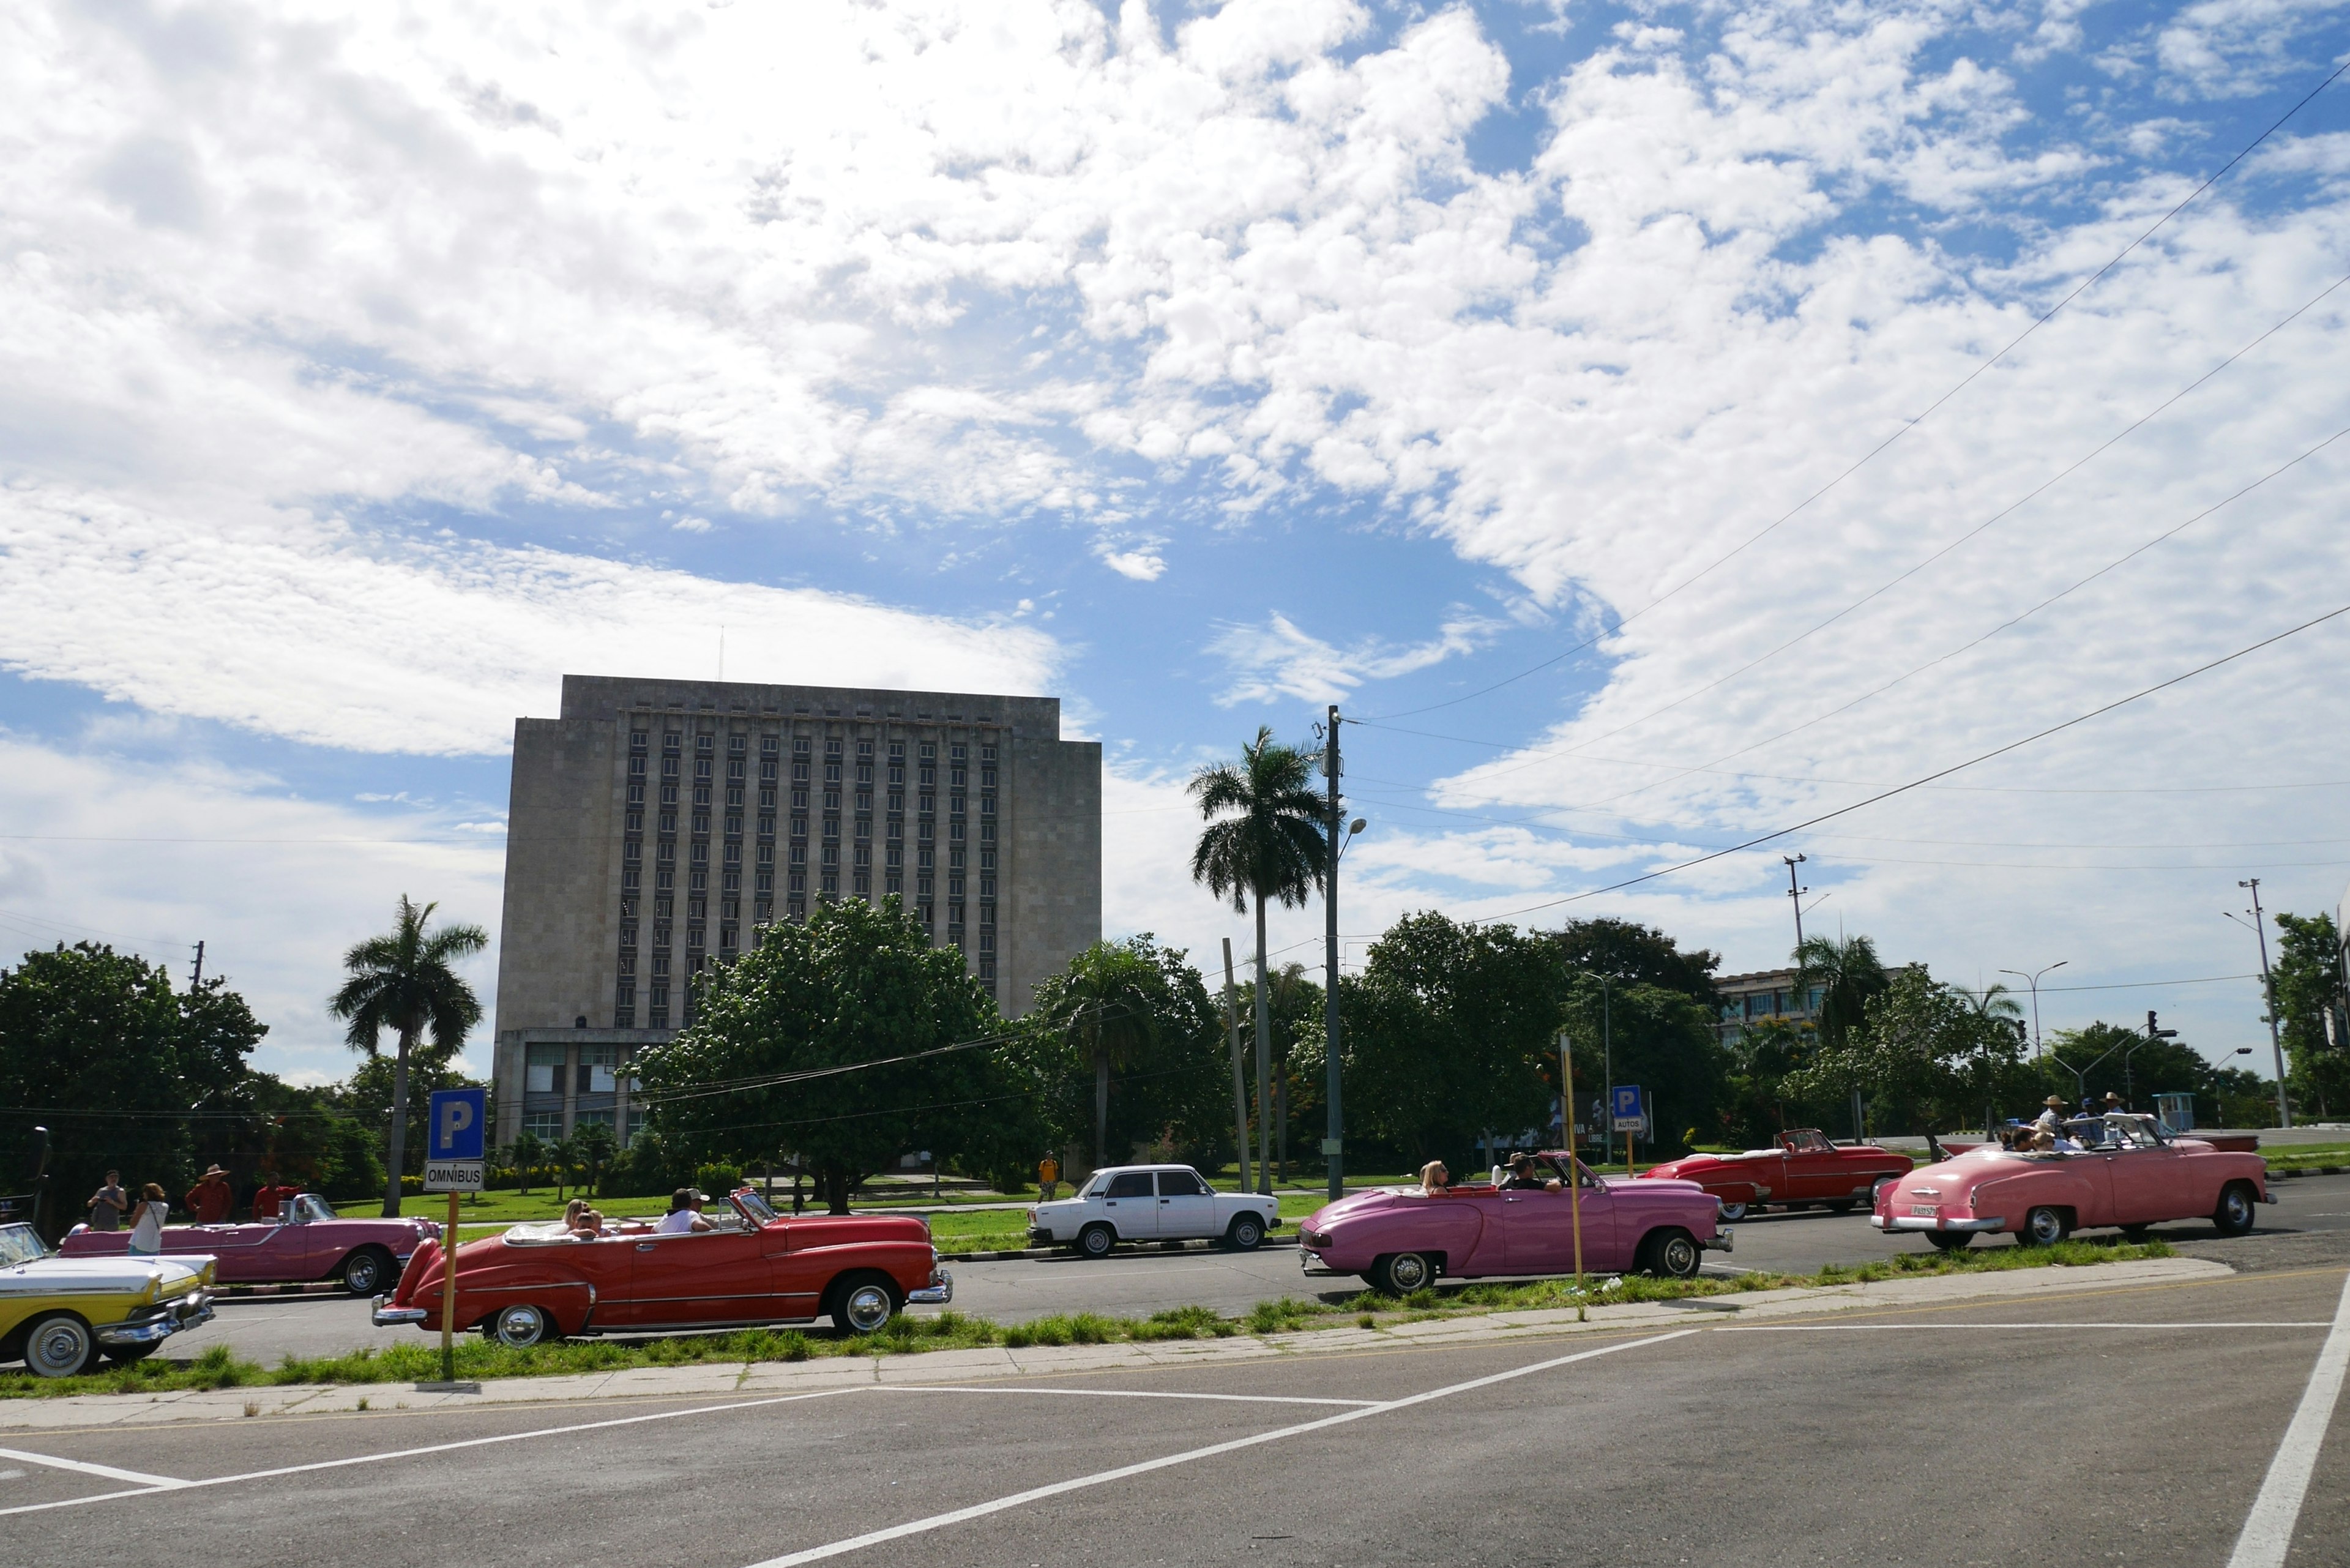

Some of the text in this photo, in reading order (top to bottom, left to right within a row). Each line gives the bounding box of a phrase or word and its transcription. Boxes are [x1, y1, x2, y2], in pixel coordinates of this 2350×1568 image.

[1619, 1091, 1635, 1113] P
[440, 1101, 473, 1149] P
[1574, 1124, 1586, 1134] IVA
[1588, 1133, 1603, 1143] LIBRE
[428, 1170, 480, 1182] OMNIBUS
